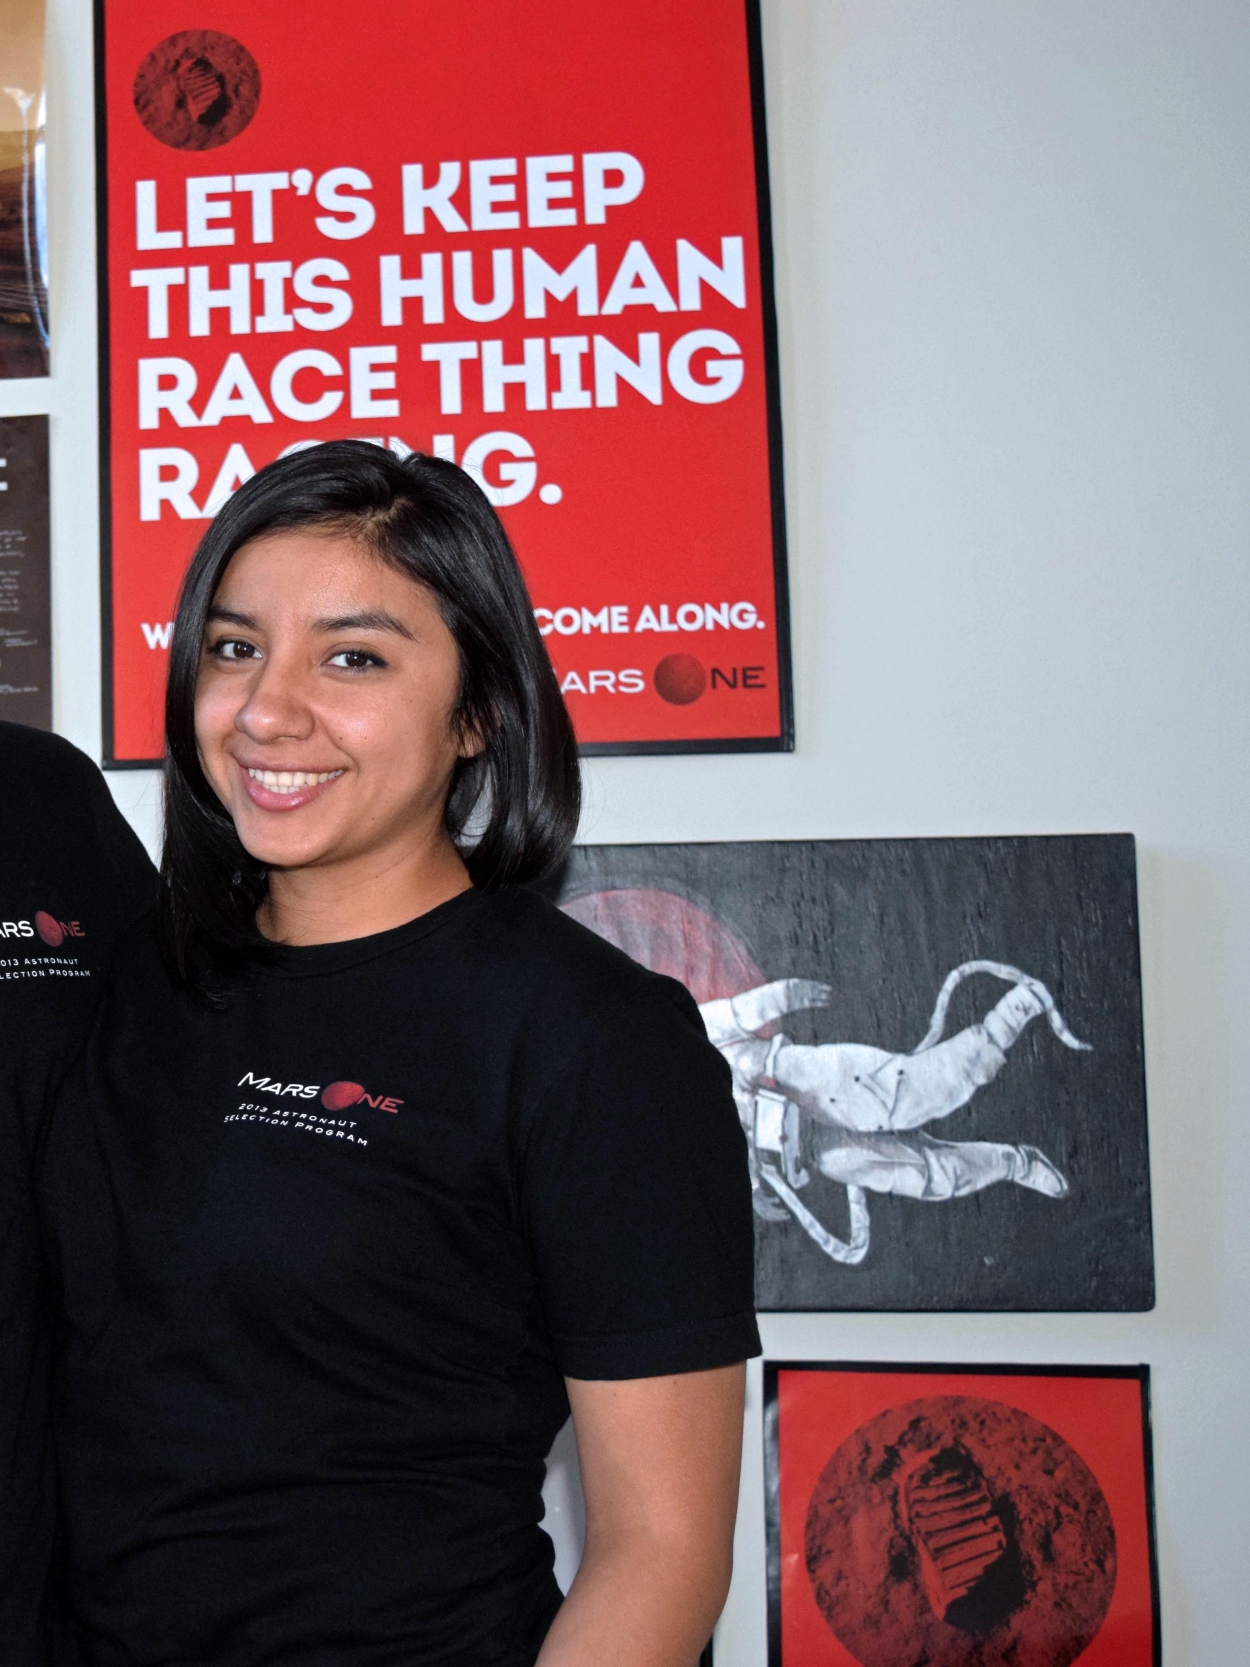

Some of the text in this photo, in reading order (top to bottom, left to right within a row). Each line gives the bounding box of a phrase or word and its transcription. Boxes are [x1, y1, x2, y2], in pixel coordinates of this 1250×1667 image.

[135, 151, 645, 251] LET'S KEEP
[130, 236, 747, 339] THIS HUMAN
[138, 328, 744, 430] RACE THING
[138, 431, 563, 522] RAG.
[533, 605, 630, 637] COME
[634, 601, 766, 632] ALONG.
[551, 668, 645, 695] ARS
[24, 957, 79, 966] ASTRONAUT
[49, 968, 91, 977] PROGRAM
[237, 1071, 321, 1099] MARS
[224, 1113, 368, 1147] SELECTION PROGRAM
[238, 1103, 357, 1129] 2013 ASTRONAUT
